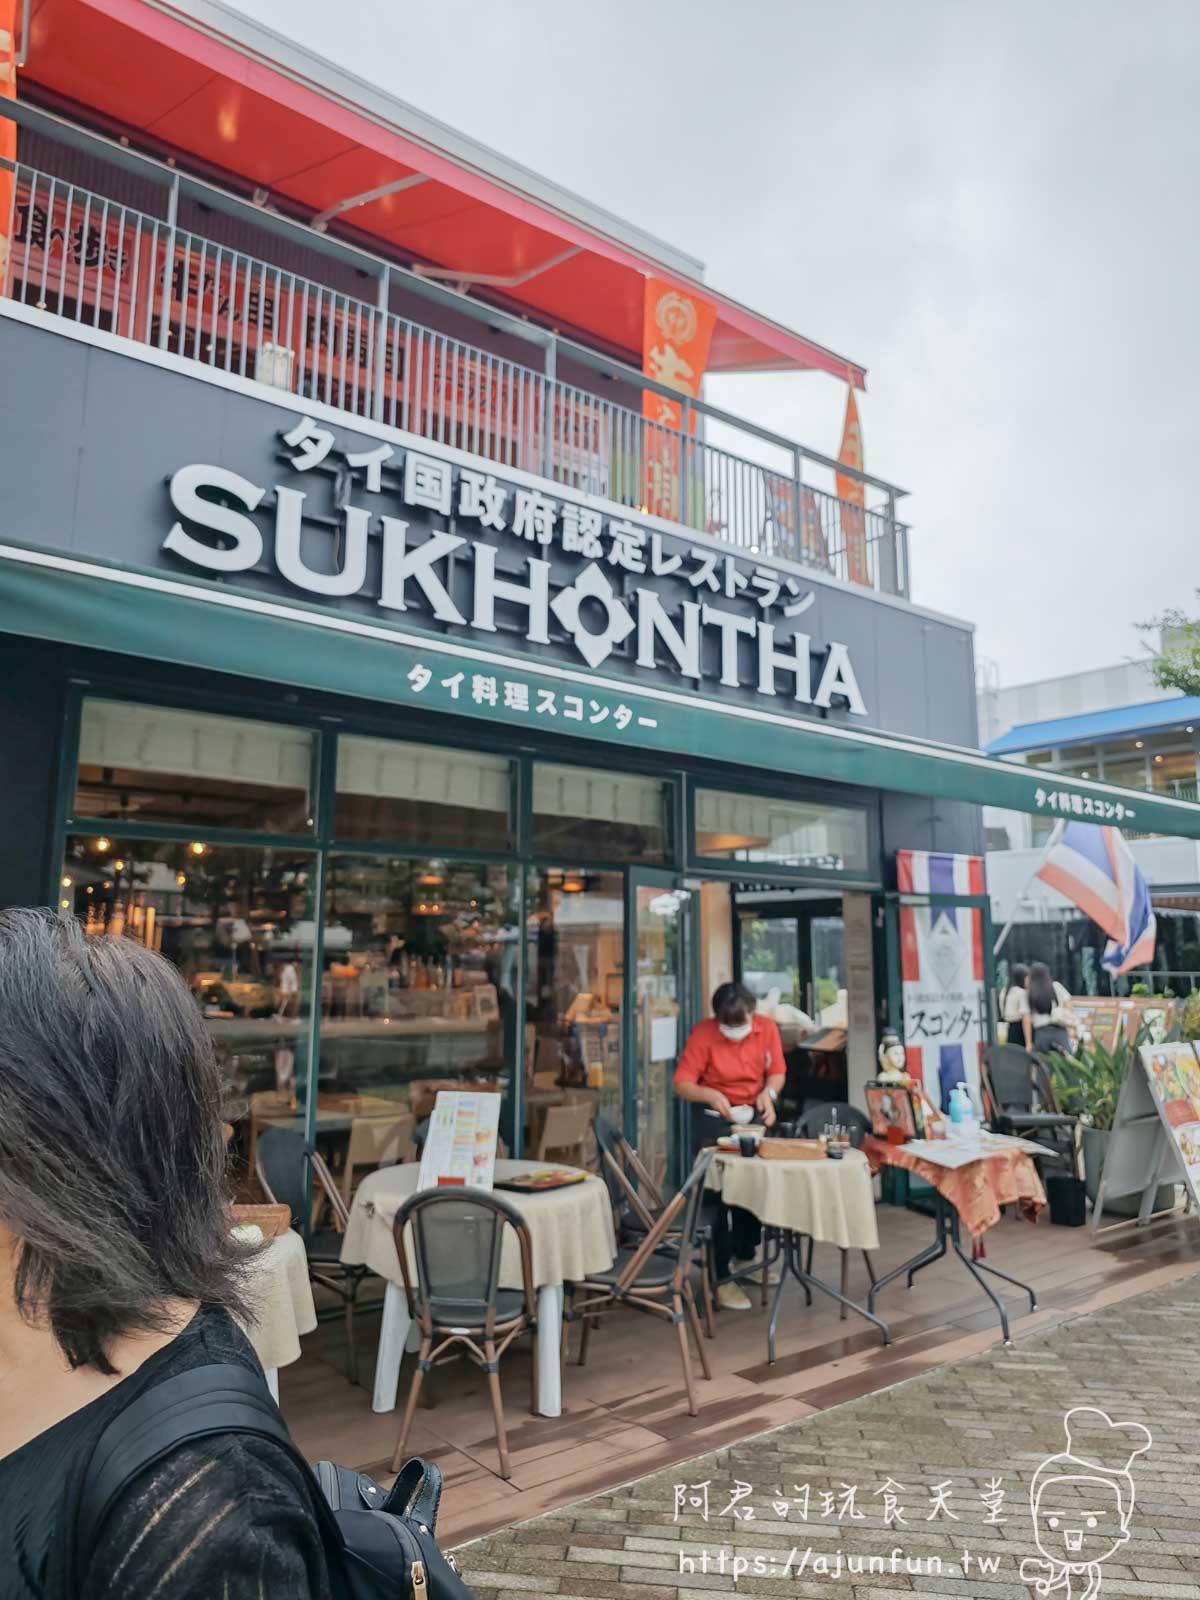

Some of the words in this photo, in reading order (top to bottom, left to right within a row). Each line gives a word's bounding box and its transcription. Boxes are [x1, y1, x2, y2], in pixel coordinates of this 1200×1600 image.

[163, 463, 867, 716] SUKHONTHA
[283, 416, 815, 617] タイ国政府認定レストラン
[407, 664, 658, 729] タイ料理スコンター
